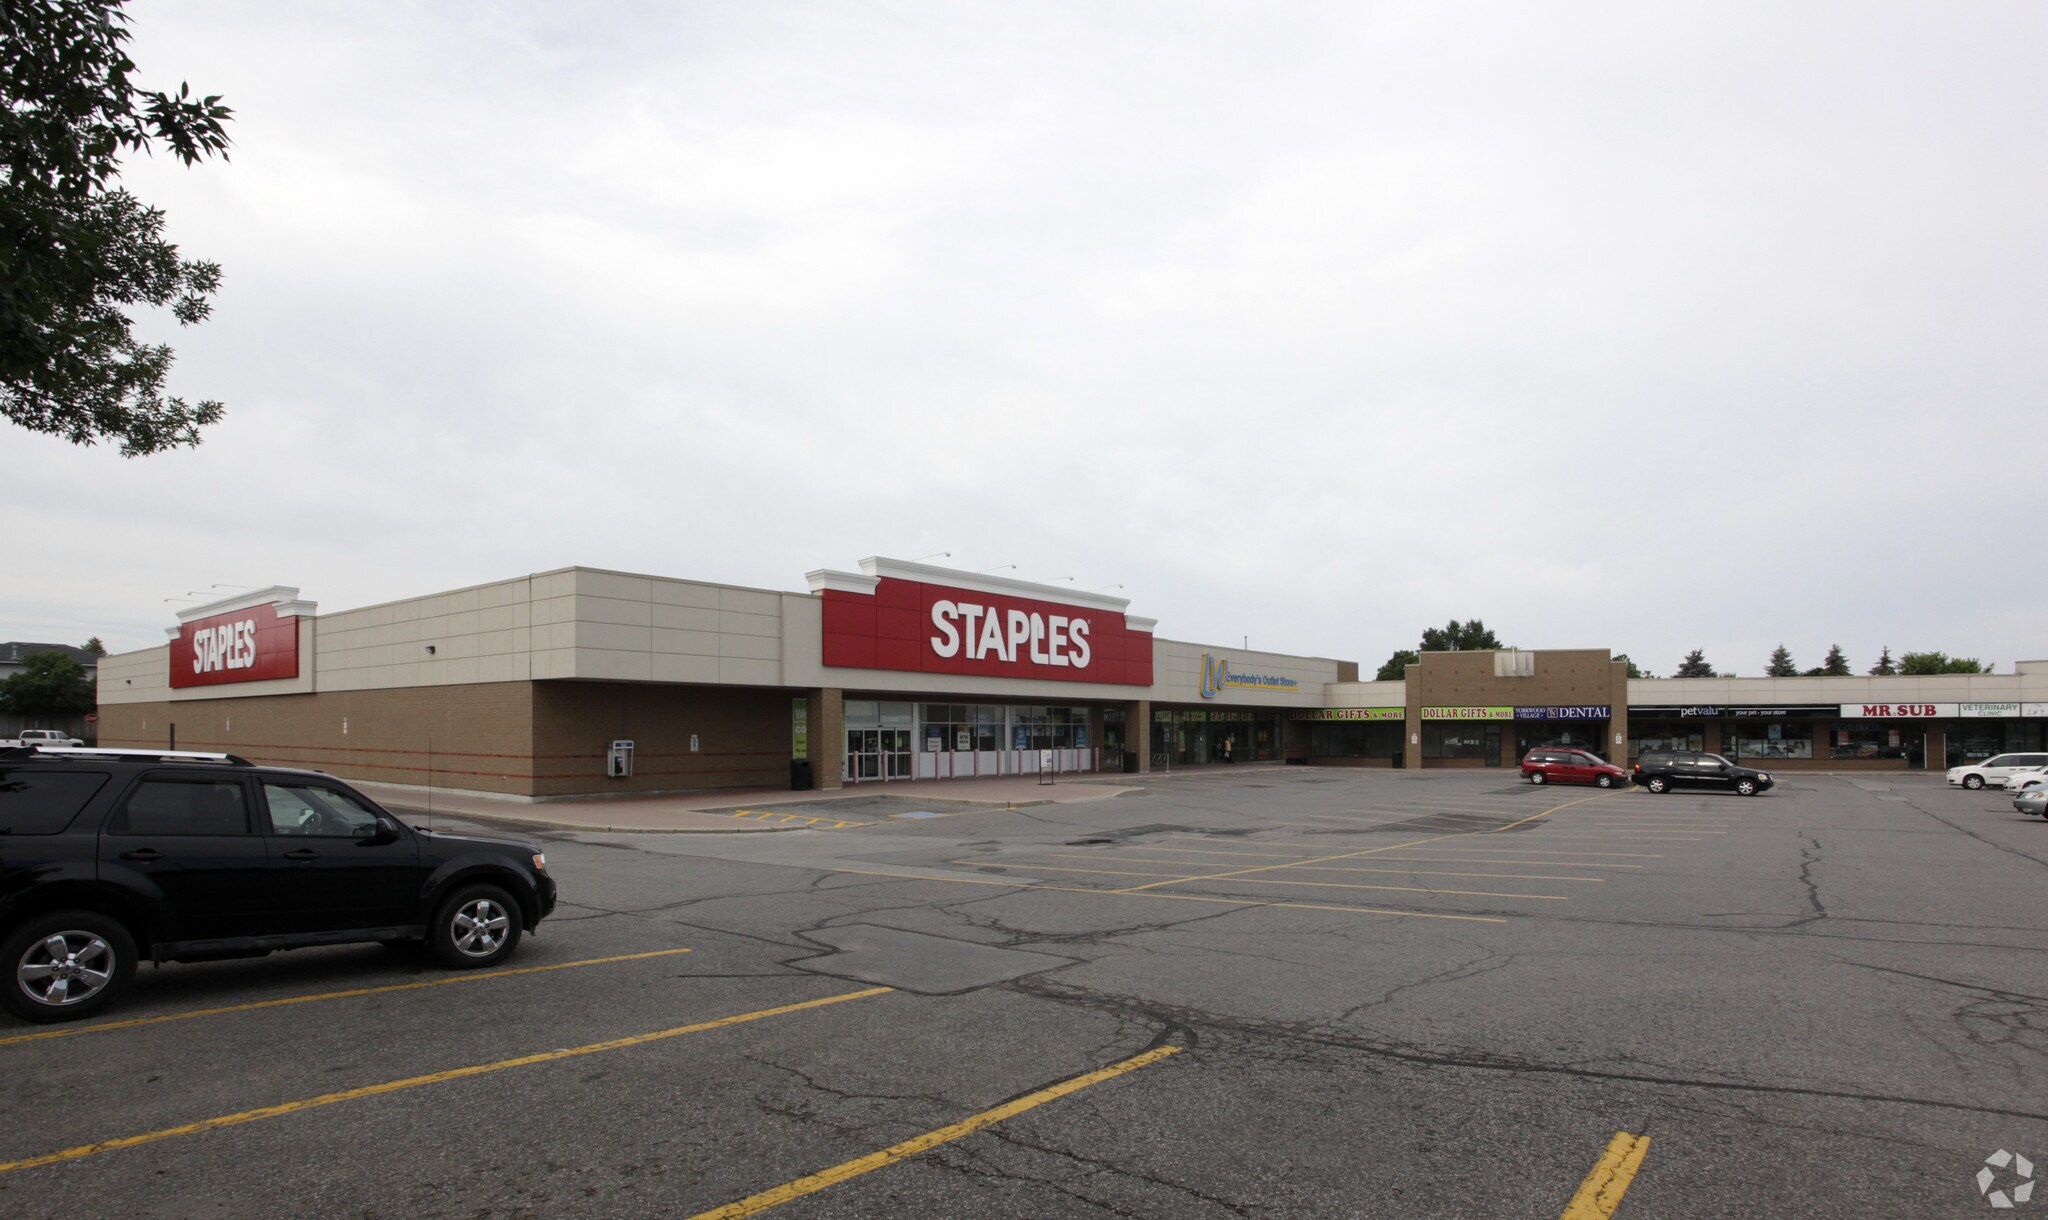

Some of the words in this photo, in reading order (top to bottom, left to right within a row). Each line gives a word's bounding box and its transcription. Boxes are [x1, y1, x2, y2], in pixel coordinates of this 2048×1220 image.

[931, 600, 1091, 669] STAPLES
[193, 619, 256, 675] STAPLES
[1227, 671, 1261, 687] Everybody's
[1263, 675, 1279, 686] Outlet
[1290, 709, 1333, 720] DOLLAR
[1336, 709, 1370, 719] GIFTS
[1381, 711, 1404, 719] MORE
[1423, 708, 1458, 718] DOLLAR
[1461, 708, 1487, 718] GIFTS
[1559, 707, 1610, 718] DENTAL
